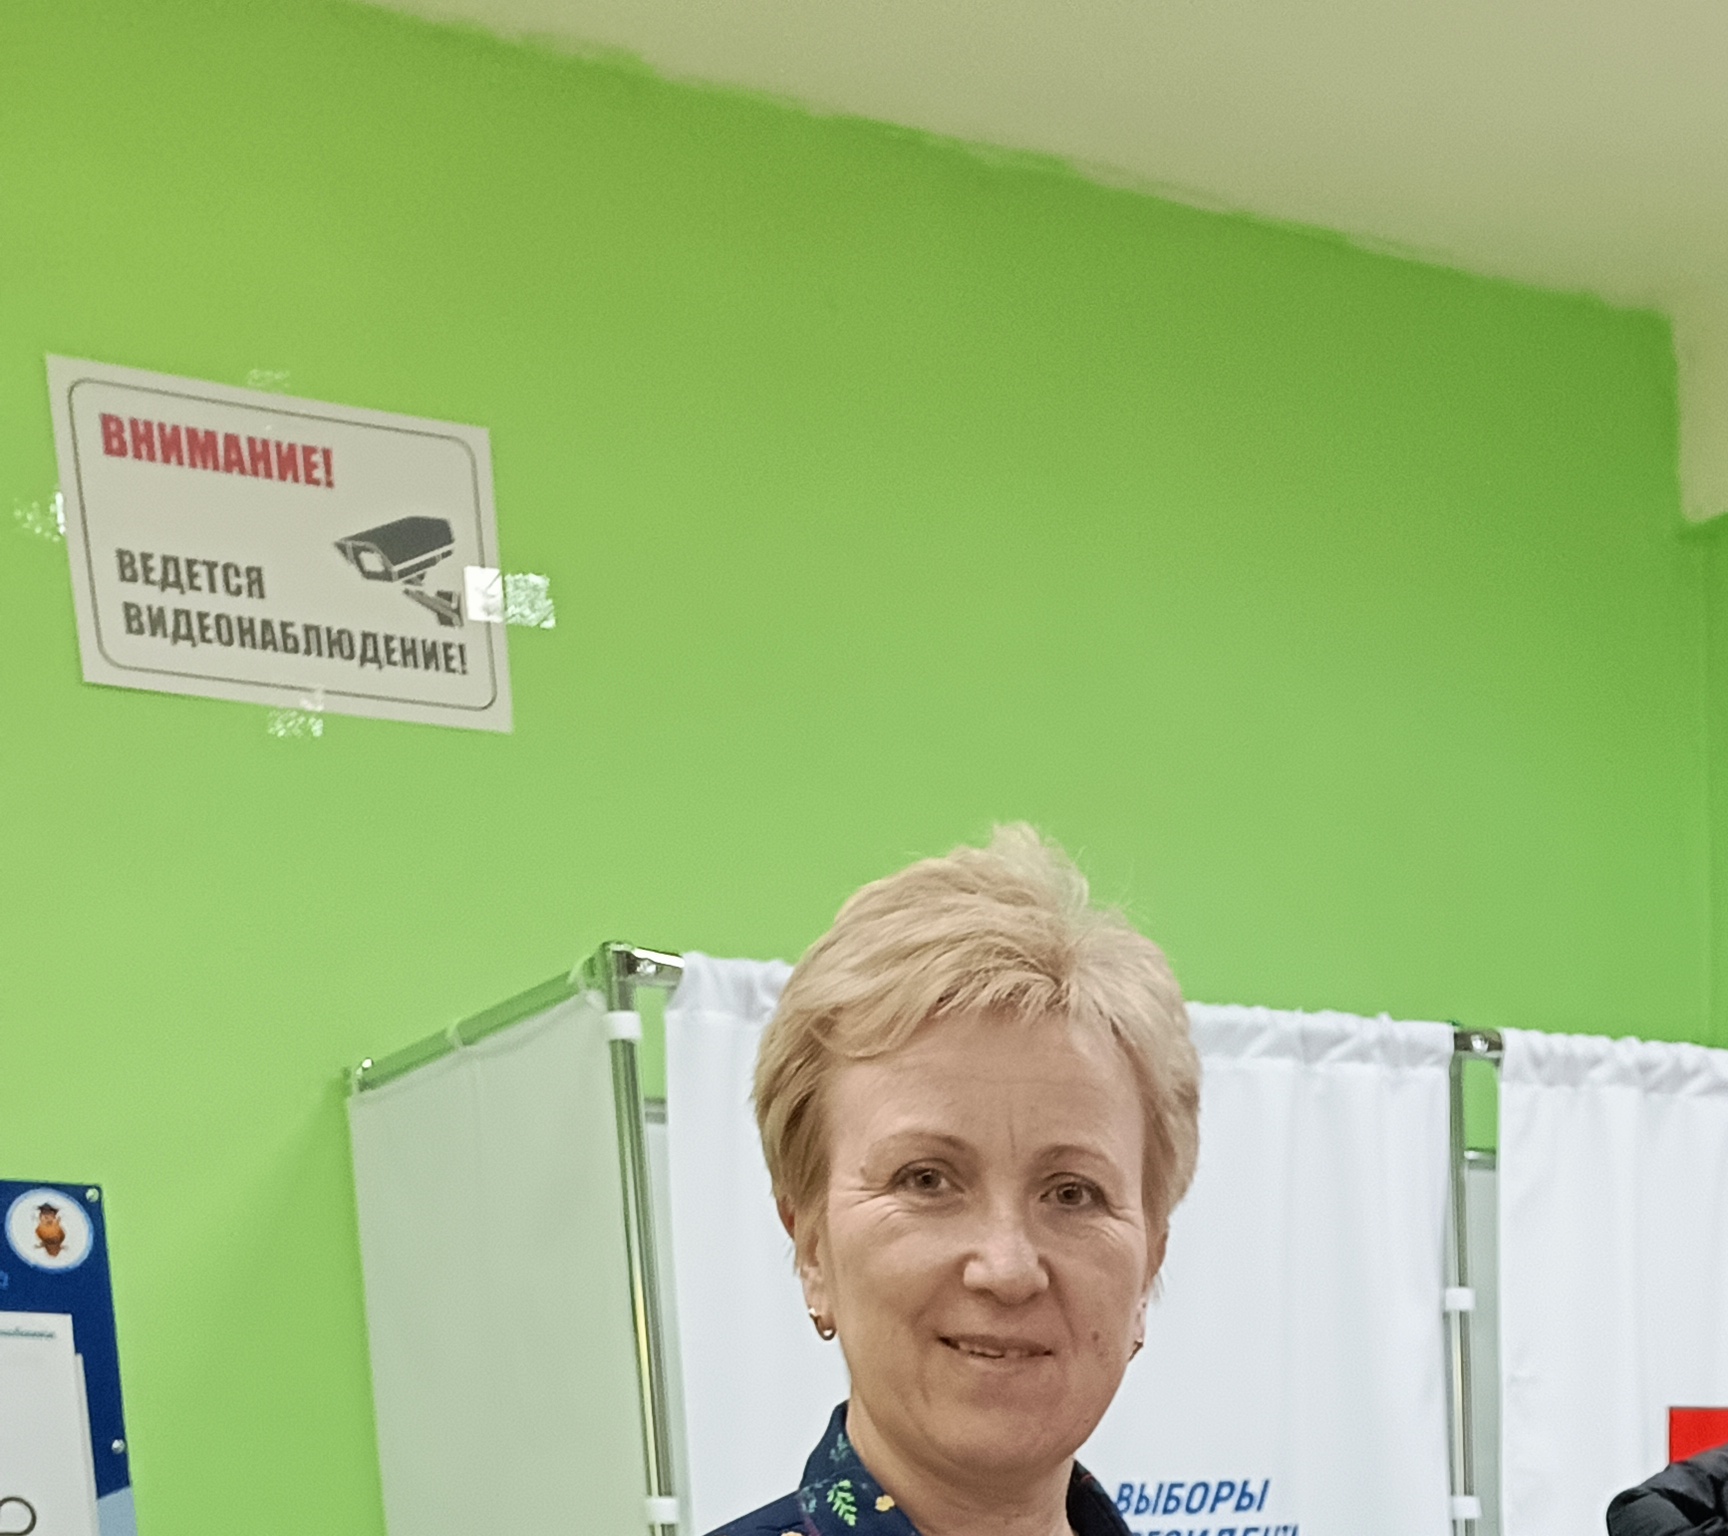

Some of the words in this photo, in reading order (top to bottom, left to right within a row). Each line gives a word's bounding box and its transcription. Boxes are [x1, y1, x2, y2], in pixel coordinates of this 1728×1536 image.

[101, 412, 335, 489] ВНИМАНИЕ!
[115, 548, 266, 600] ВЕДЕТСЯ
[123, 601, 468, 676] ВИДЕОНАБЛЮДЕНИЕ!
[1116, 1479, 1270, 1516] ВЫБОРЫ
